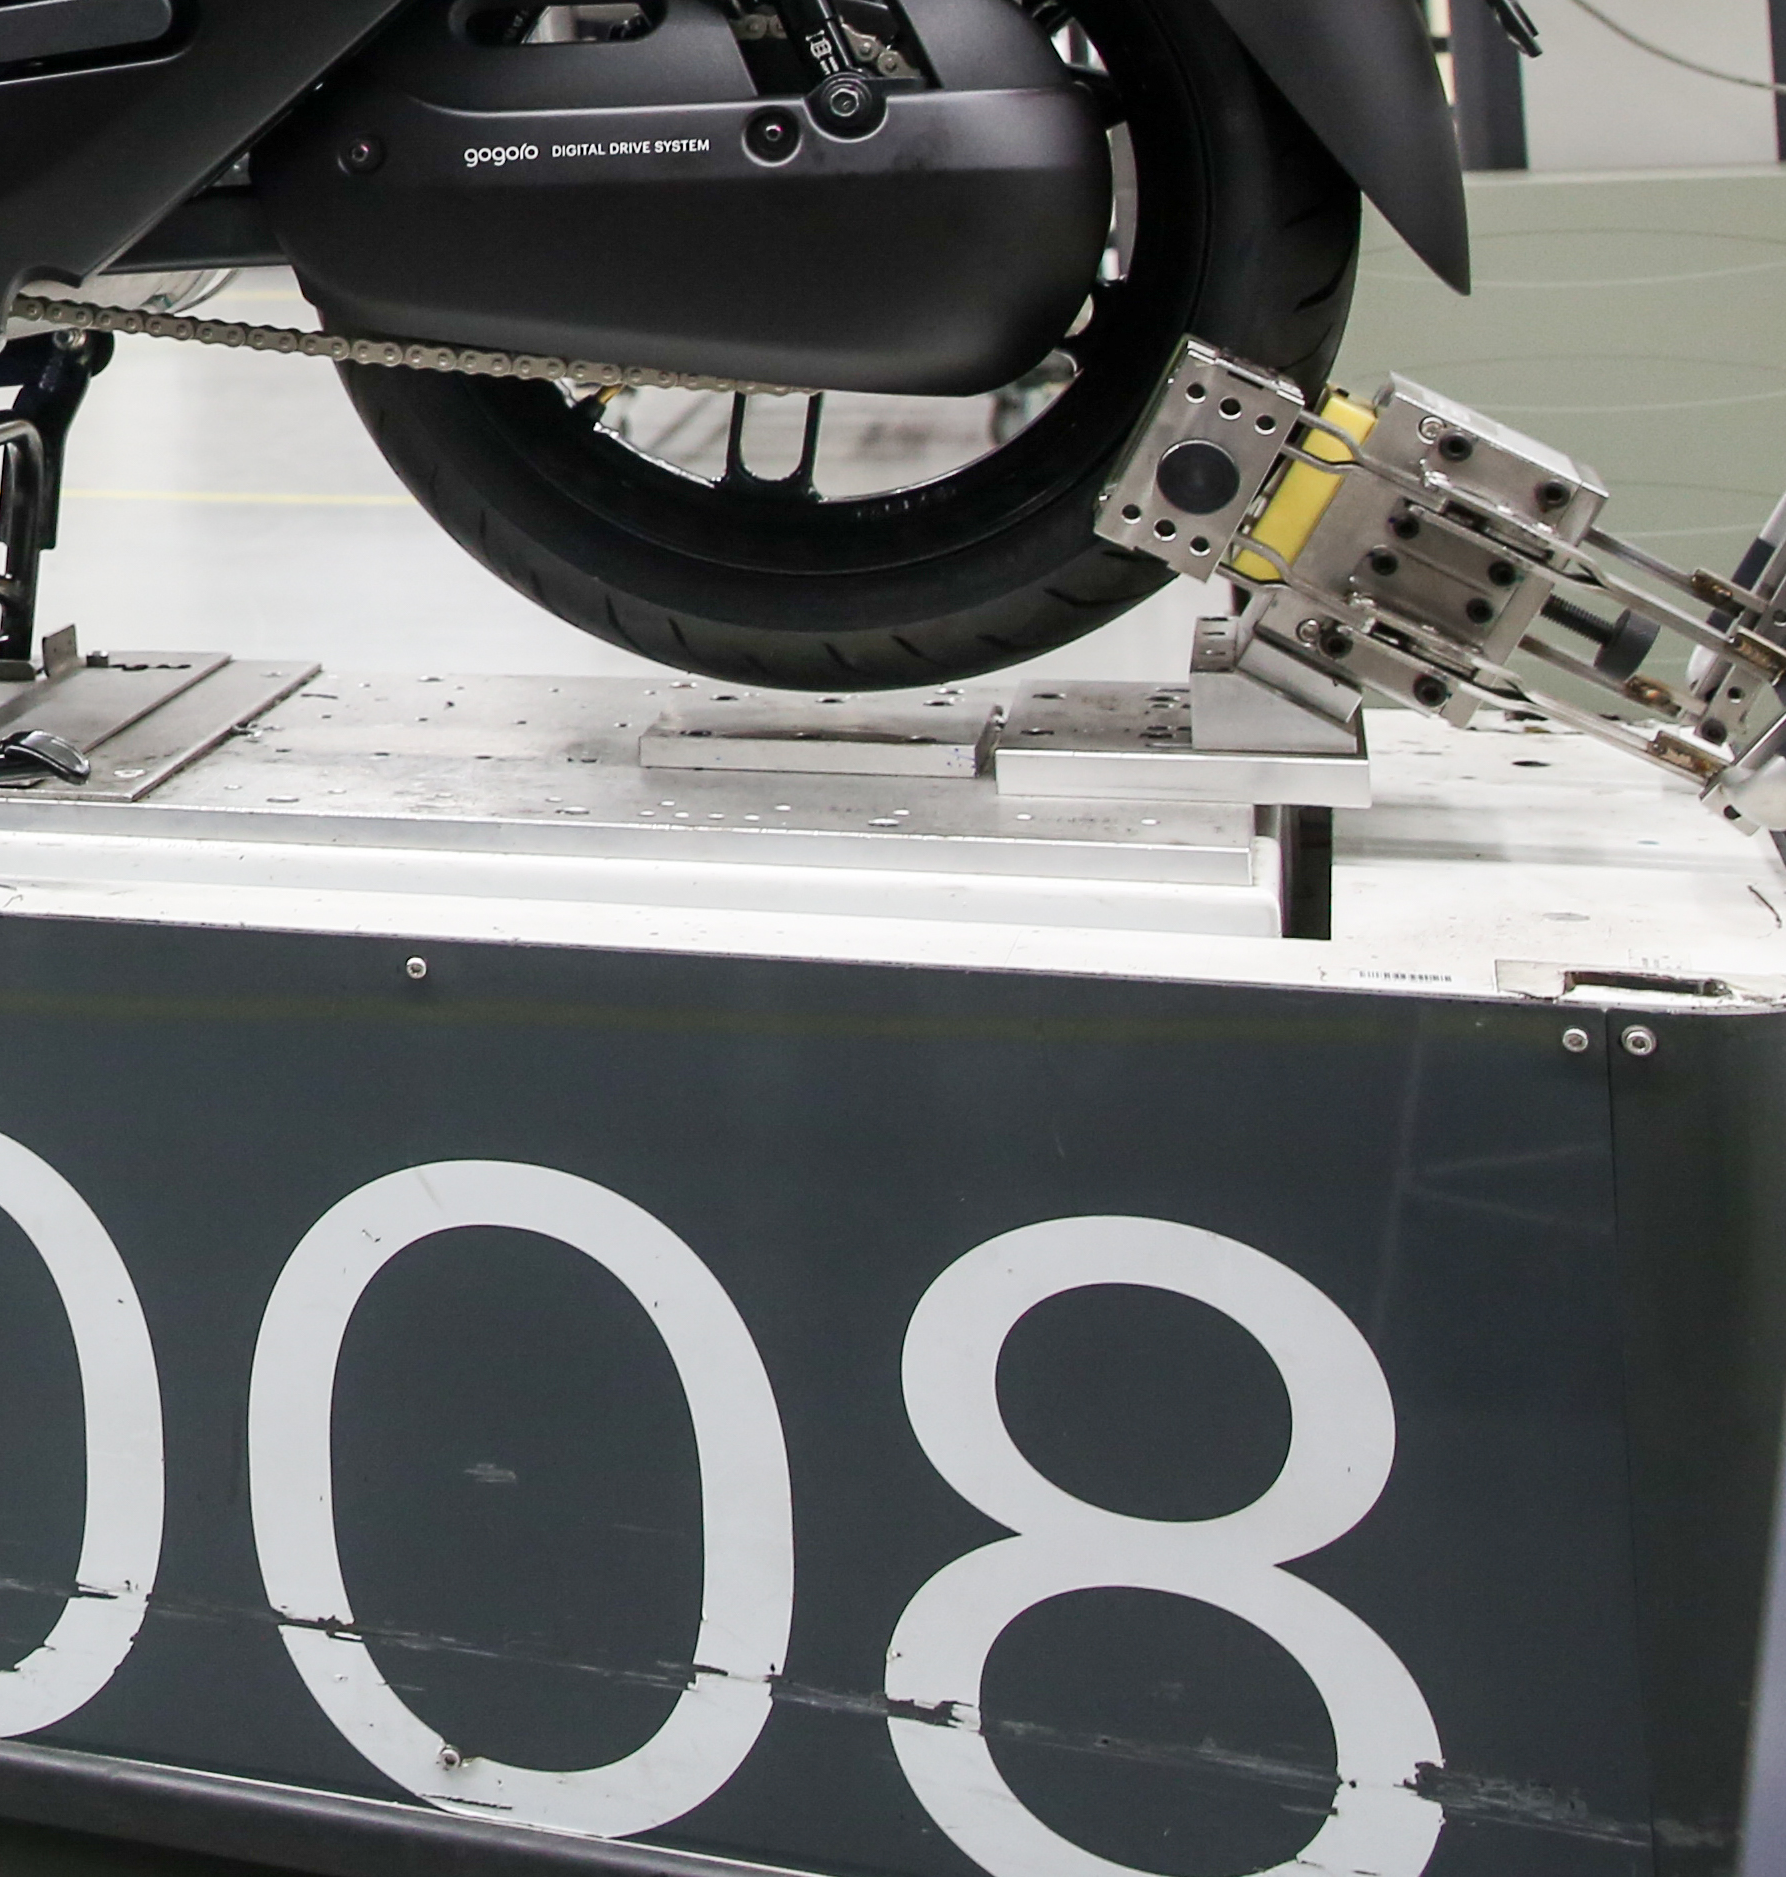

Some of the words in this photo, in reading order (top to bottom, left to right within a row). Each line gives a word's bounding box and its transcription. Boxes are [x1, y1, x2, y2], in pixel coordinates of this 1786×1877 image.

[463, 142, 539, 168] gogoro
[551, 143, 606, 158] DIGITAL
[609, 140, 651, 154] DRIVE
[654, 138, 710, 153] SYSTEM
